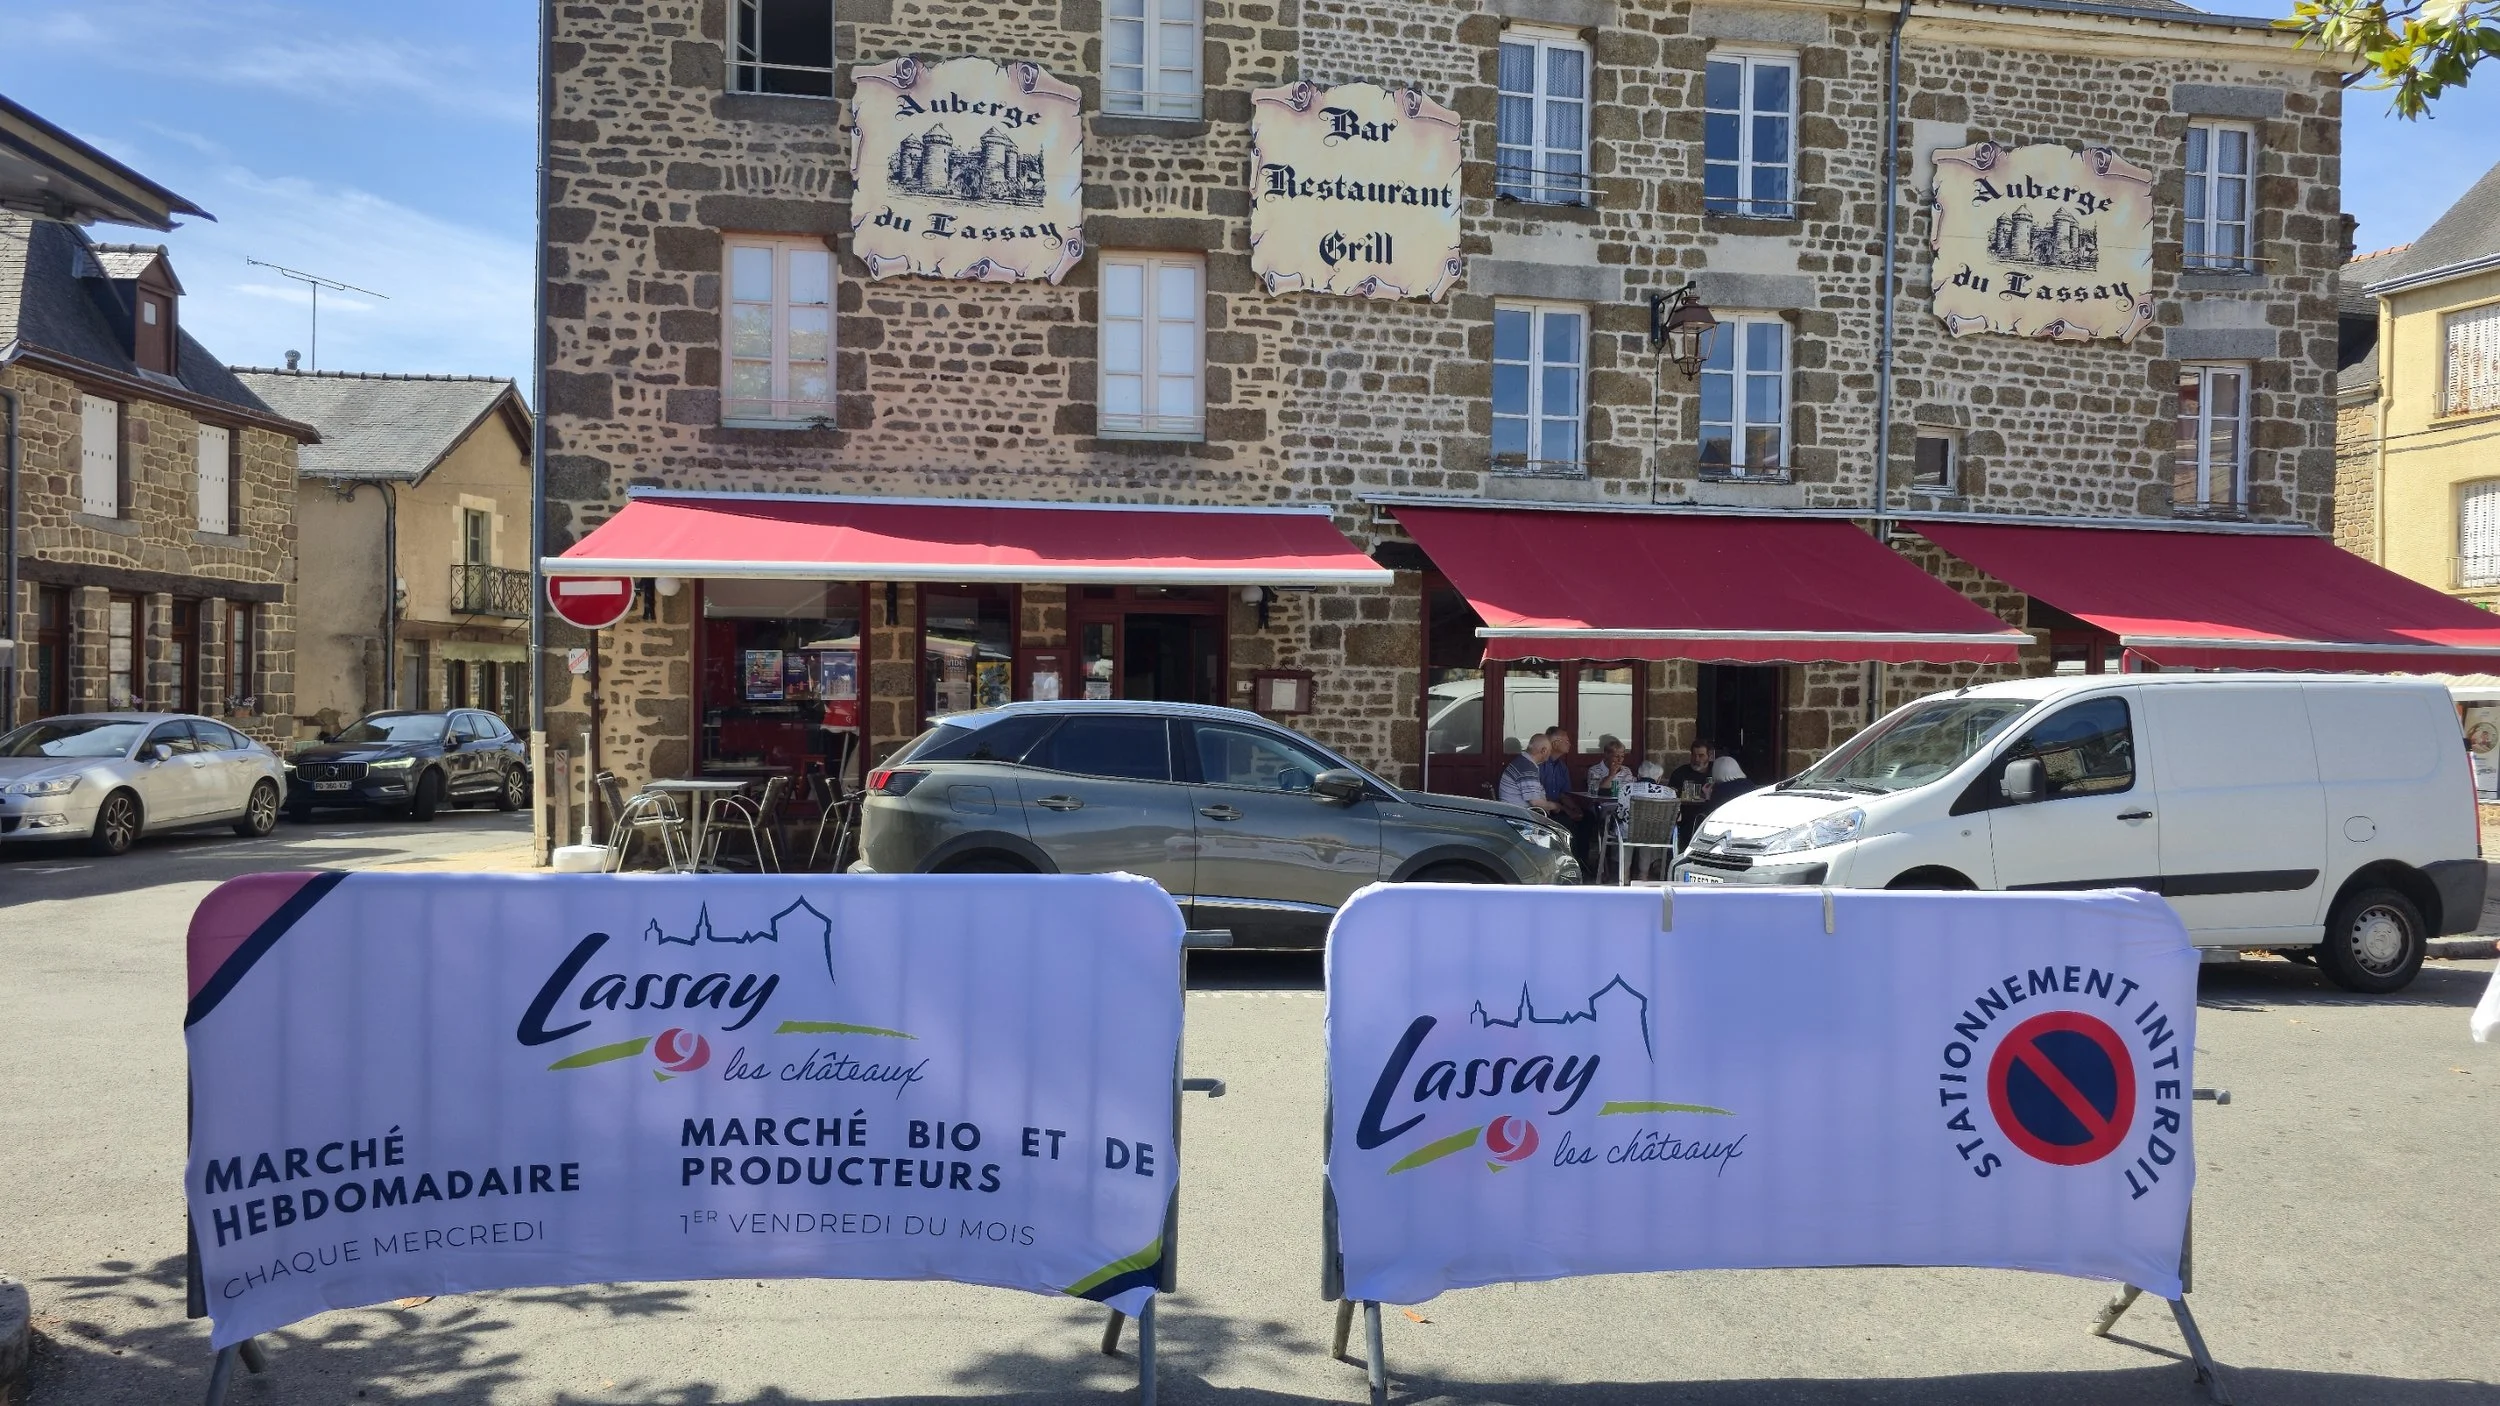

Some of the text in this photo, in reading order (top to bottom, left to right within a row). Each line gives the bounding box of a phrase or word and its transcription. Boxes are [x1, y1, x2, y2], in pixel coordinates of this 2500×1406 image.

[895, 92, 1042, 128] Auberge
[1319, 107, 1398, 147] Bar
[1261, 164, 1452, 208] Restaurant
[1972, 175, 2113, 215] Auberge
[874, 205, 1063, 249] du Lassay
[1319, 231, 1393, 272] Grill
[1952, 263, 2134, 312] du Lassay
[516, 932, 779, 1046] Lassay
[724, 1046, 929, 1099] les châteaux
[1356, 1015, 1600, 1150] Lassay
[1940, 965, 2181, 1200] STATIONNEMENT INTERDIT
[205, 1125, 404, 1194] MARCHÉ
[681, 1108, 1154, 1176] MARCHÉ BIO ET DE
[1554, 1127, 1747, 1177] les châteaux
[682, 1156, 1001, 1192] PRODUCTEURS
[212, 1162, 580, 1247] HEBDOMADAIRE
[729, 1213, 890, 1234] VENDREDI
[905, 1215, 946, 1236] DU
[960, 1219, 1035, 1246] MOIS
[223, 1220, 544, 1299] CHAQUE MERCREDI
